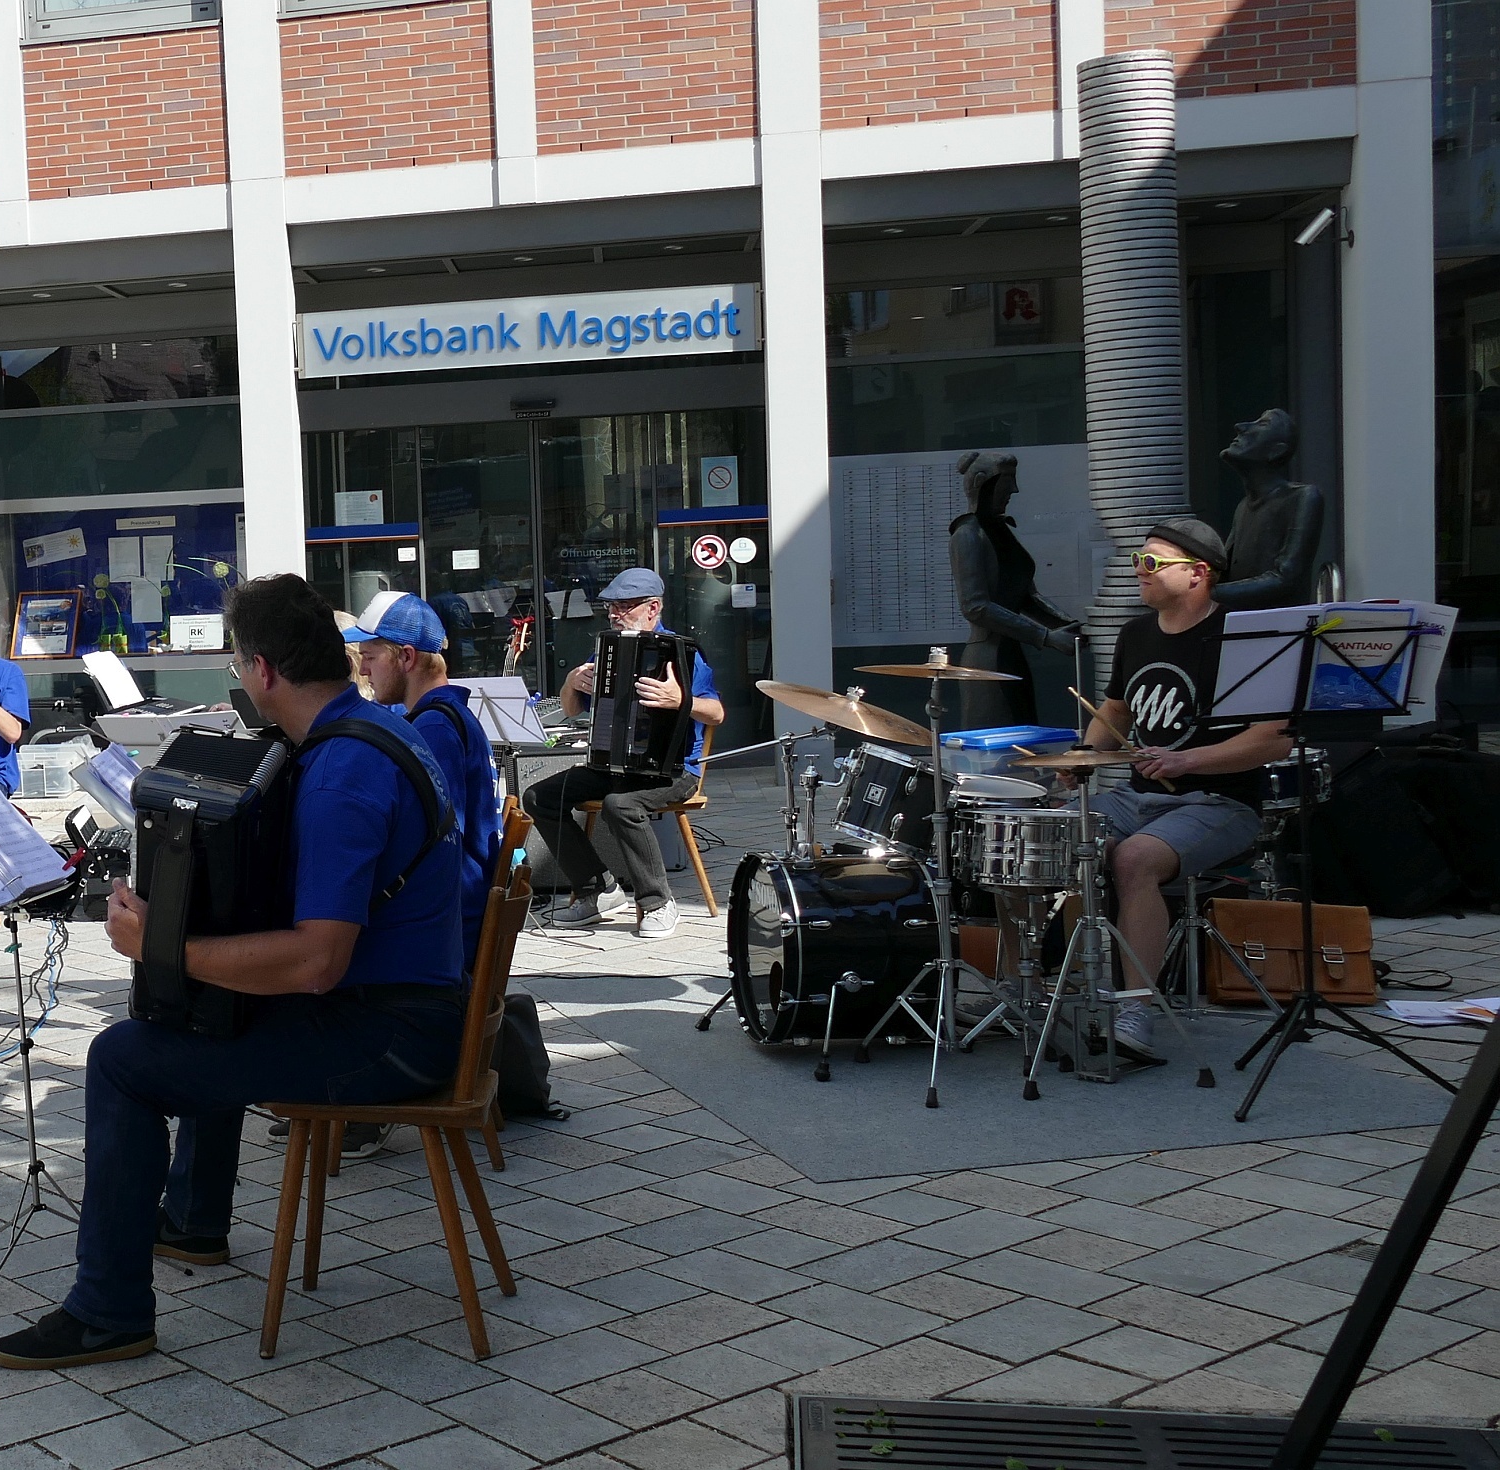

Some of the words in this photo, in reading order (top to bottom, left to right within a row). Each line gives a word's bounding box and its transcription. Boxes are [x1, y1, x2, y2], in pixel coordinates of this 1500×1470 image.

[313, 313, 520, 361] Volksbank
[538, 298, 741, 353] Magstadt
[190, 628, 204, 636] RK
[604, 645, 613, 694] HOHNER
